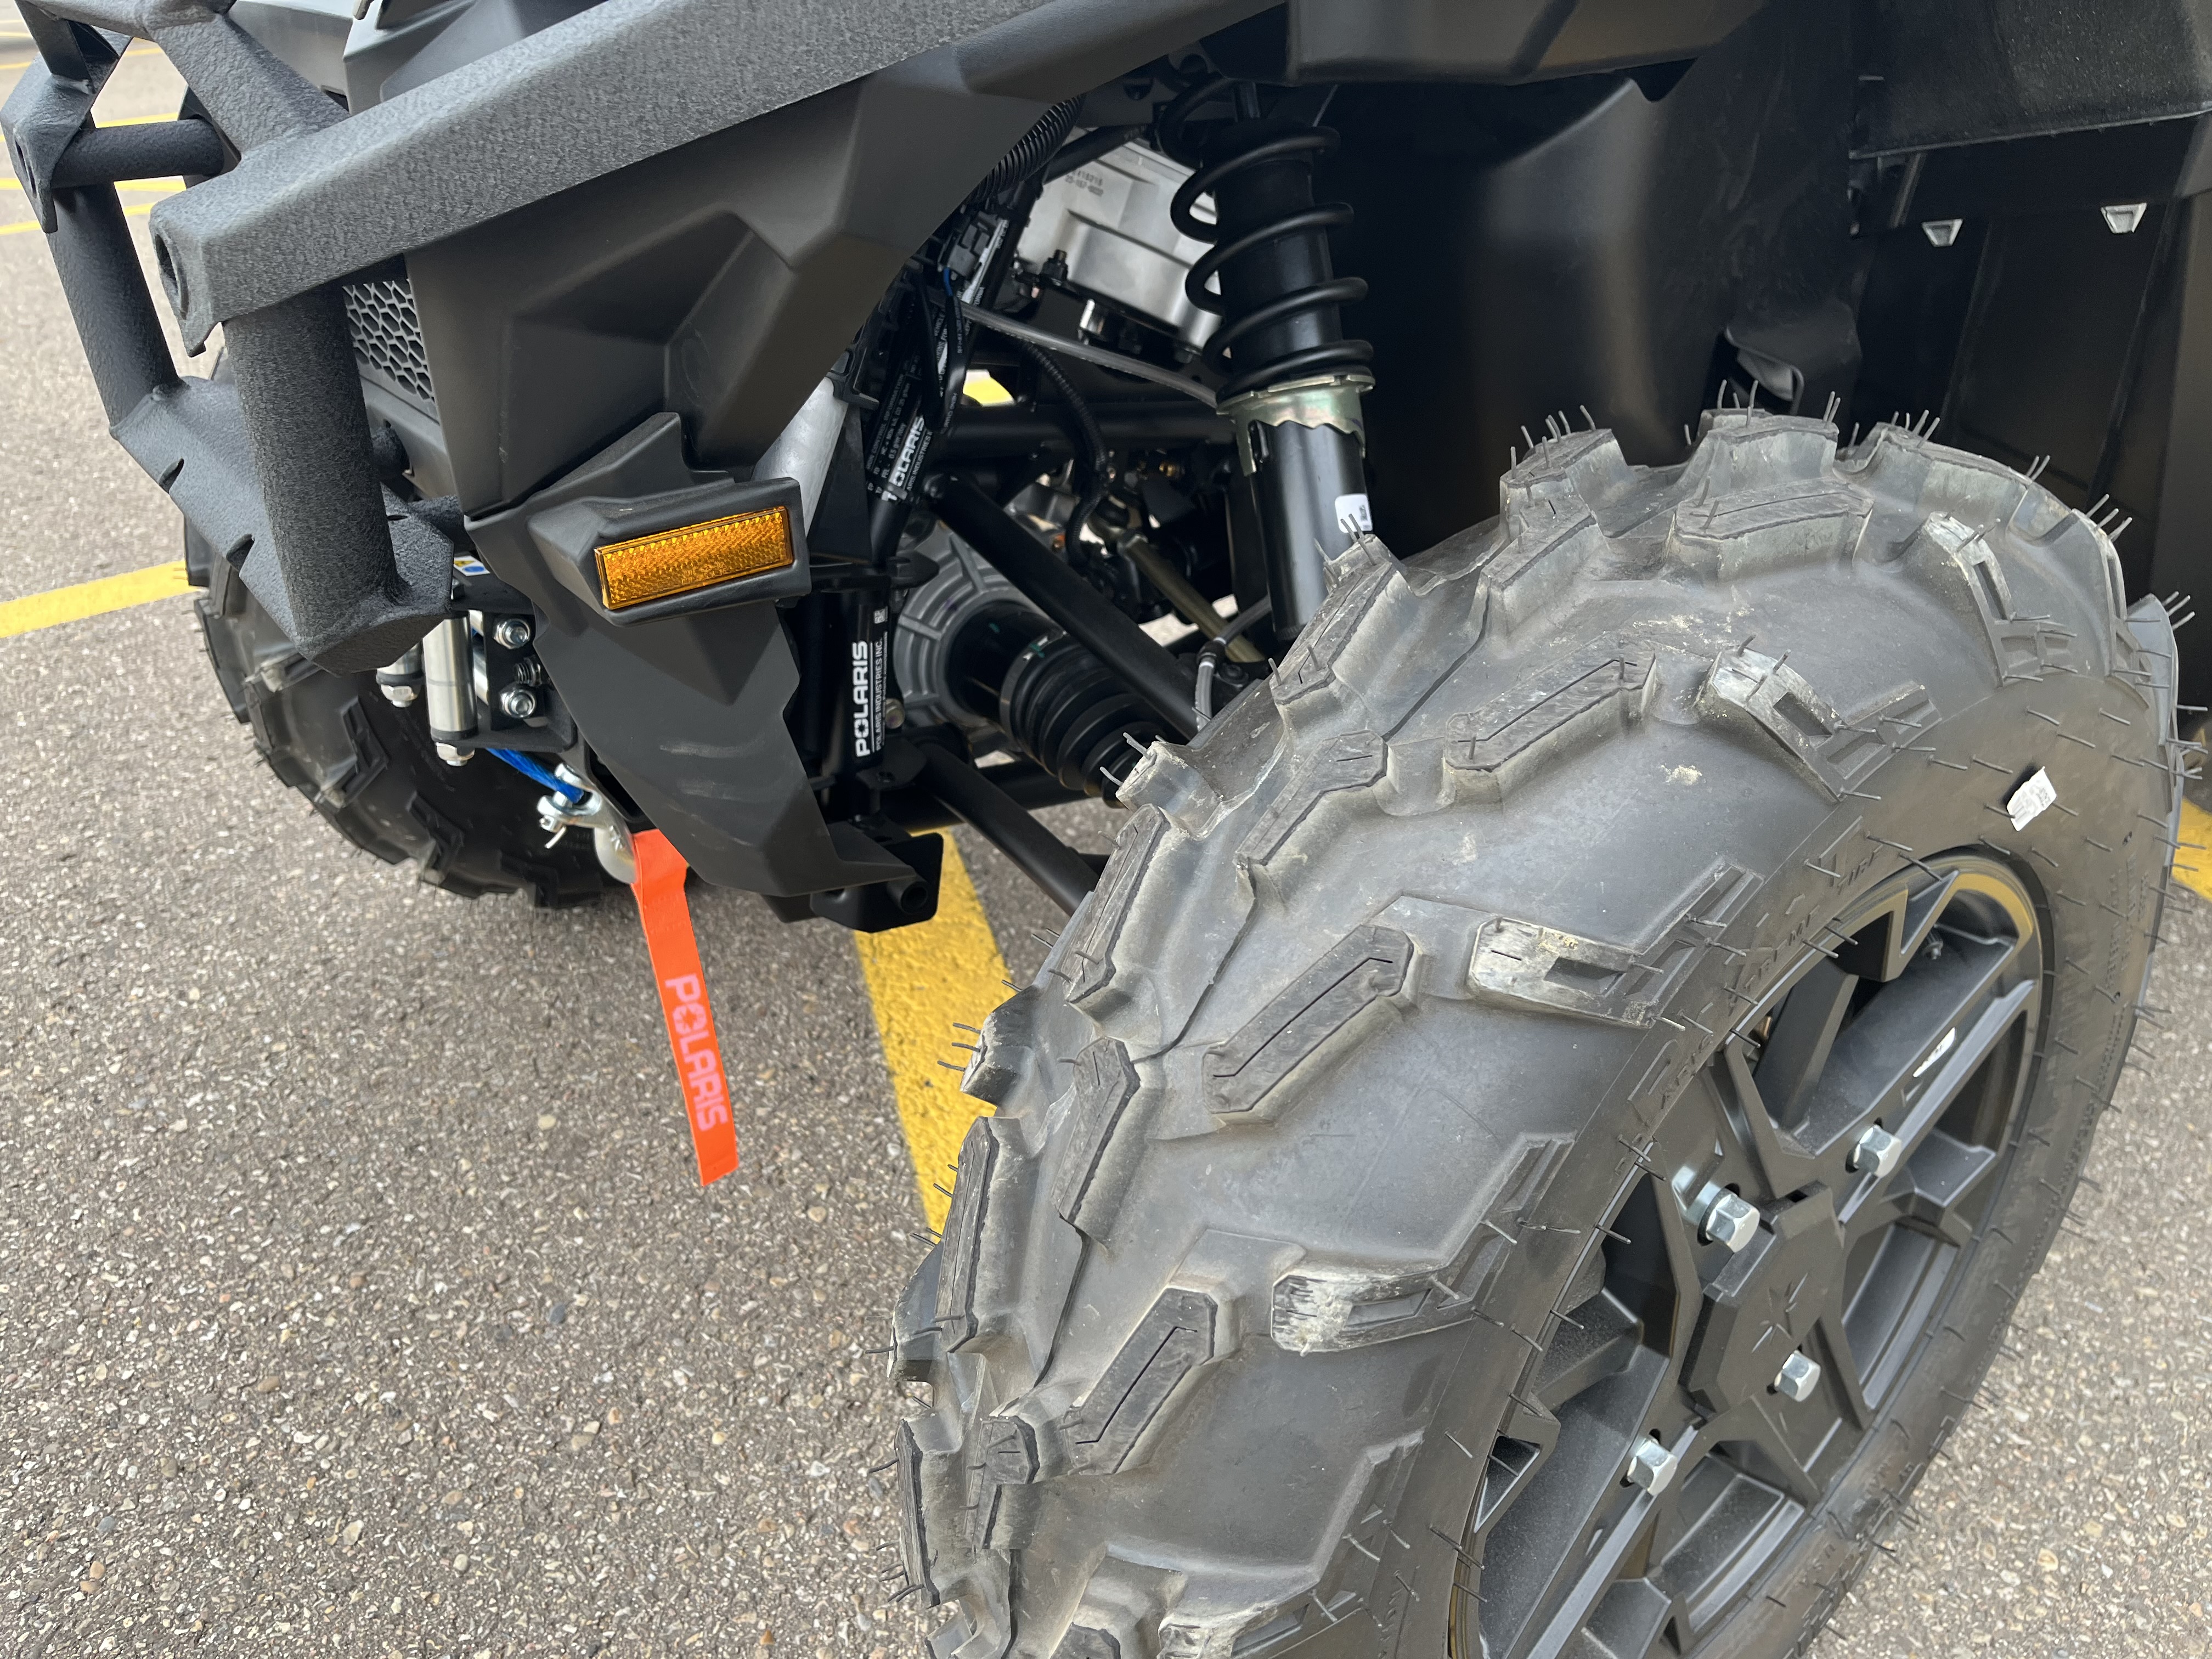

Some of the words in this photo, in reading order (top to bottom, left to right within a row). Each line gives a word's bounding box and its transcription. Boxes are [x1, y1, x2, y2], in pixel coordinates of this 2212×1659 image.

[851, 640, 871, 758] POLARIS
[874, 658, 883, 709] INDUSTRIES
[664, 972, 729, 1132] POLARIS
